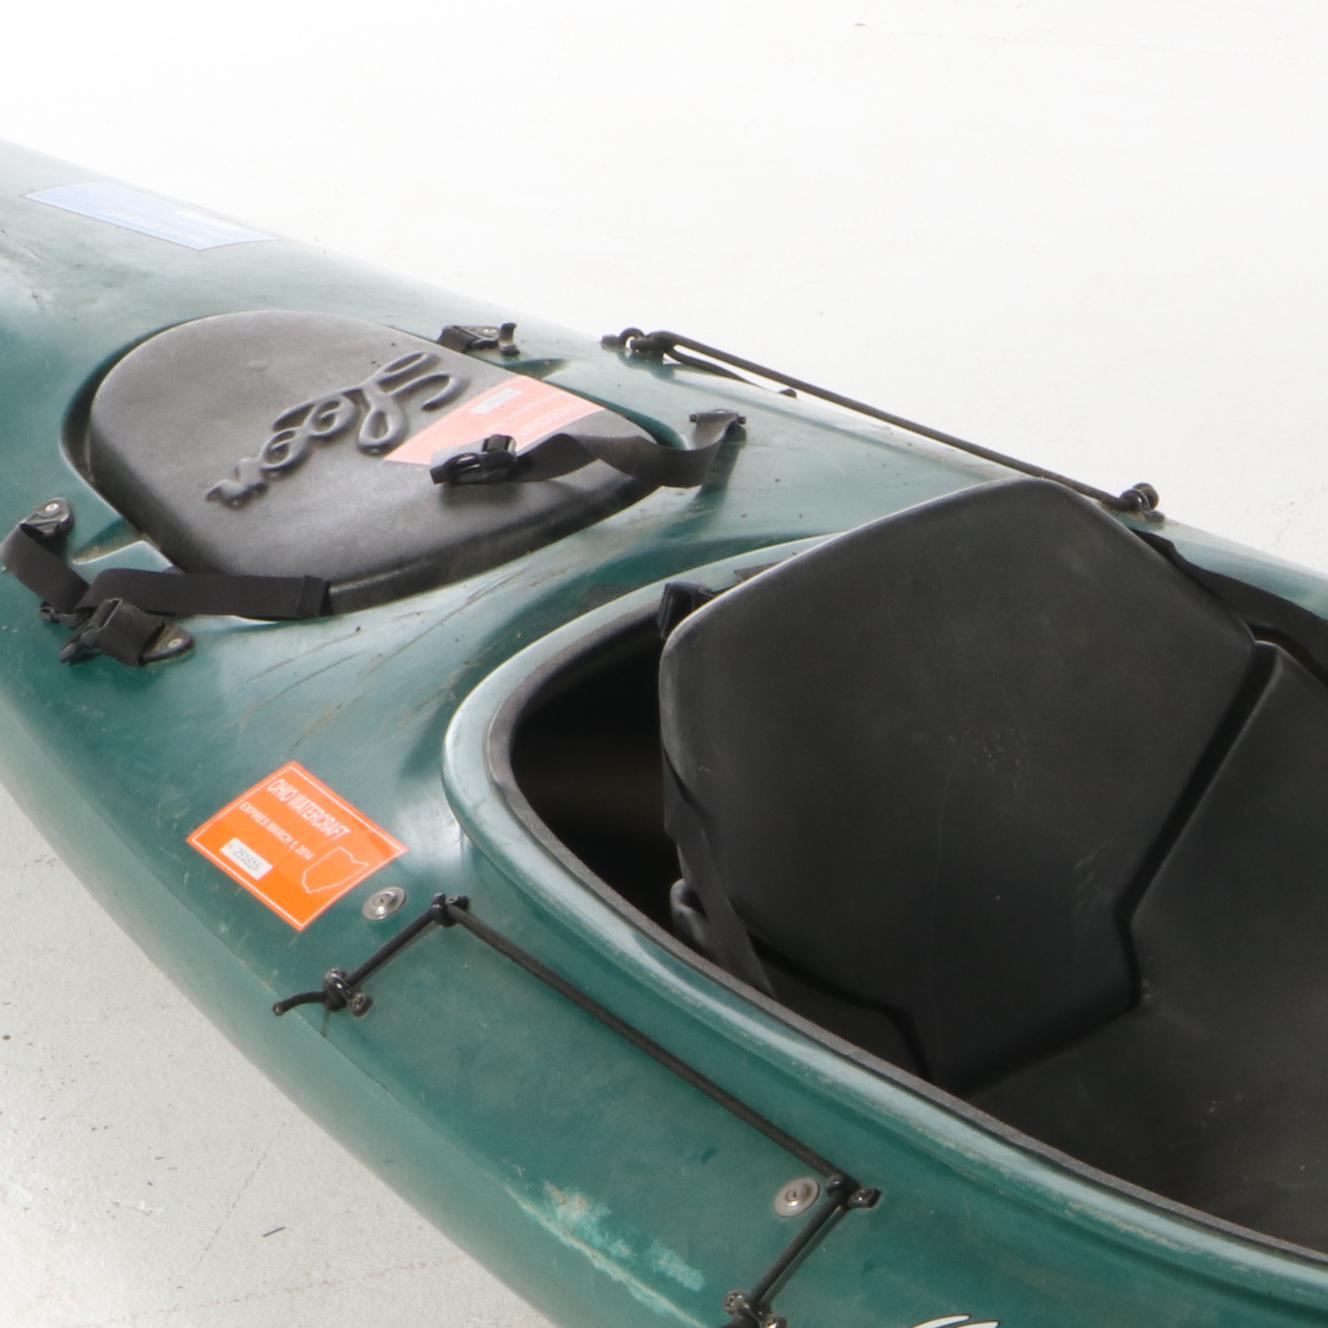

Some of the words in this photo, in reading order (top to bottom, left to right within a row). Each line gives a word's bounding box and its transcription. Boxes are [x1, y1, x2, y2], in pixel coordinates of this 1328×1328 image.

[239, 802, 270, 827] EXPIRES
[265, 823, 293, 845] MARCH
[266, 778, 297, 802] OHIO
[287, 794, 351, 840] WATERCRAFT
